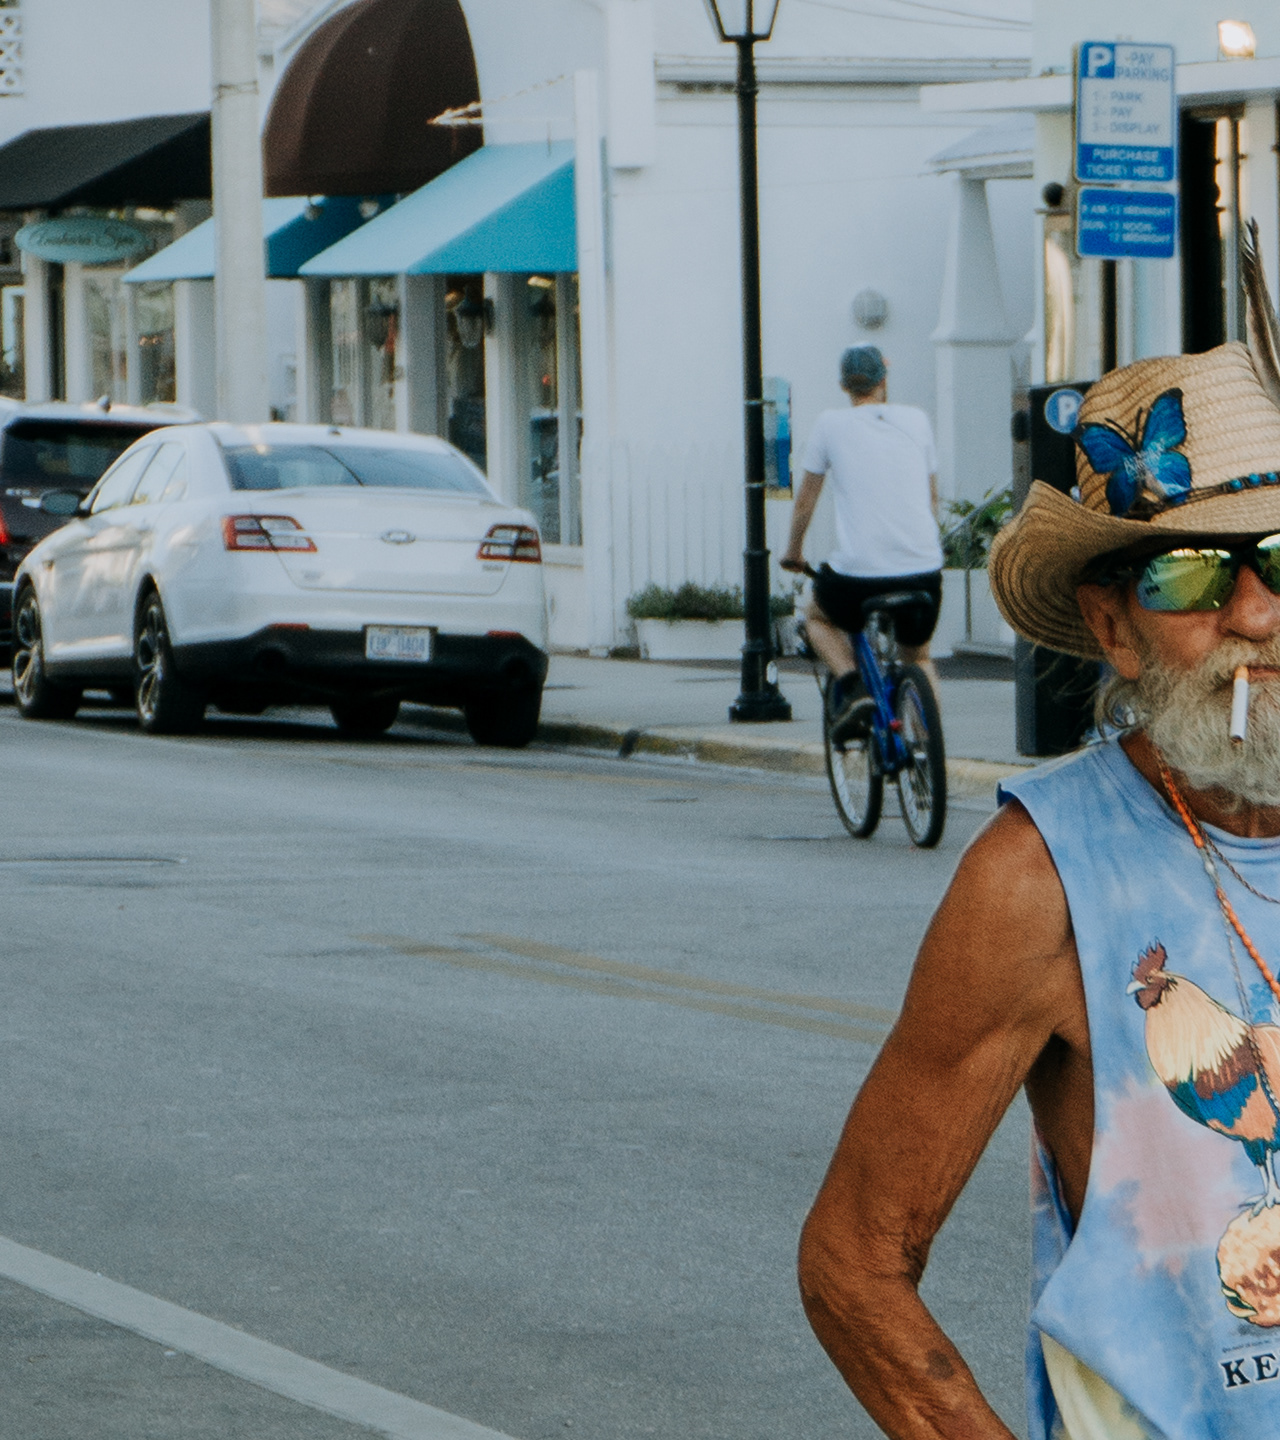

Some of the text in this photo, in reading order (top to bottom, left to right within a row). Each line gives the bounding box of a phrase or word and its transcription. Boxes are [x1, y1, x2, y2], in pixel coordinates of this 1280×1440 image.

[1116, 67, 1169, 82] PARKING
[1092, 148, 1159, 162] PURCHASE
[1086, 163, 1165, 178] TICKET HERE
